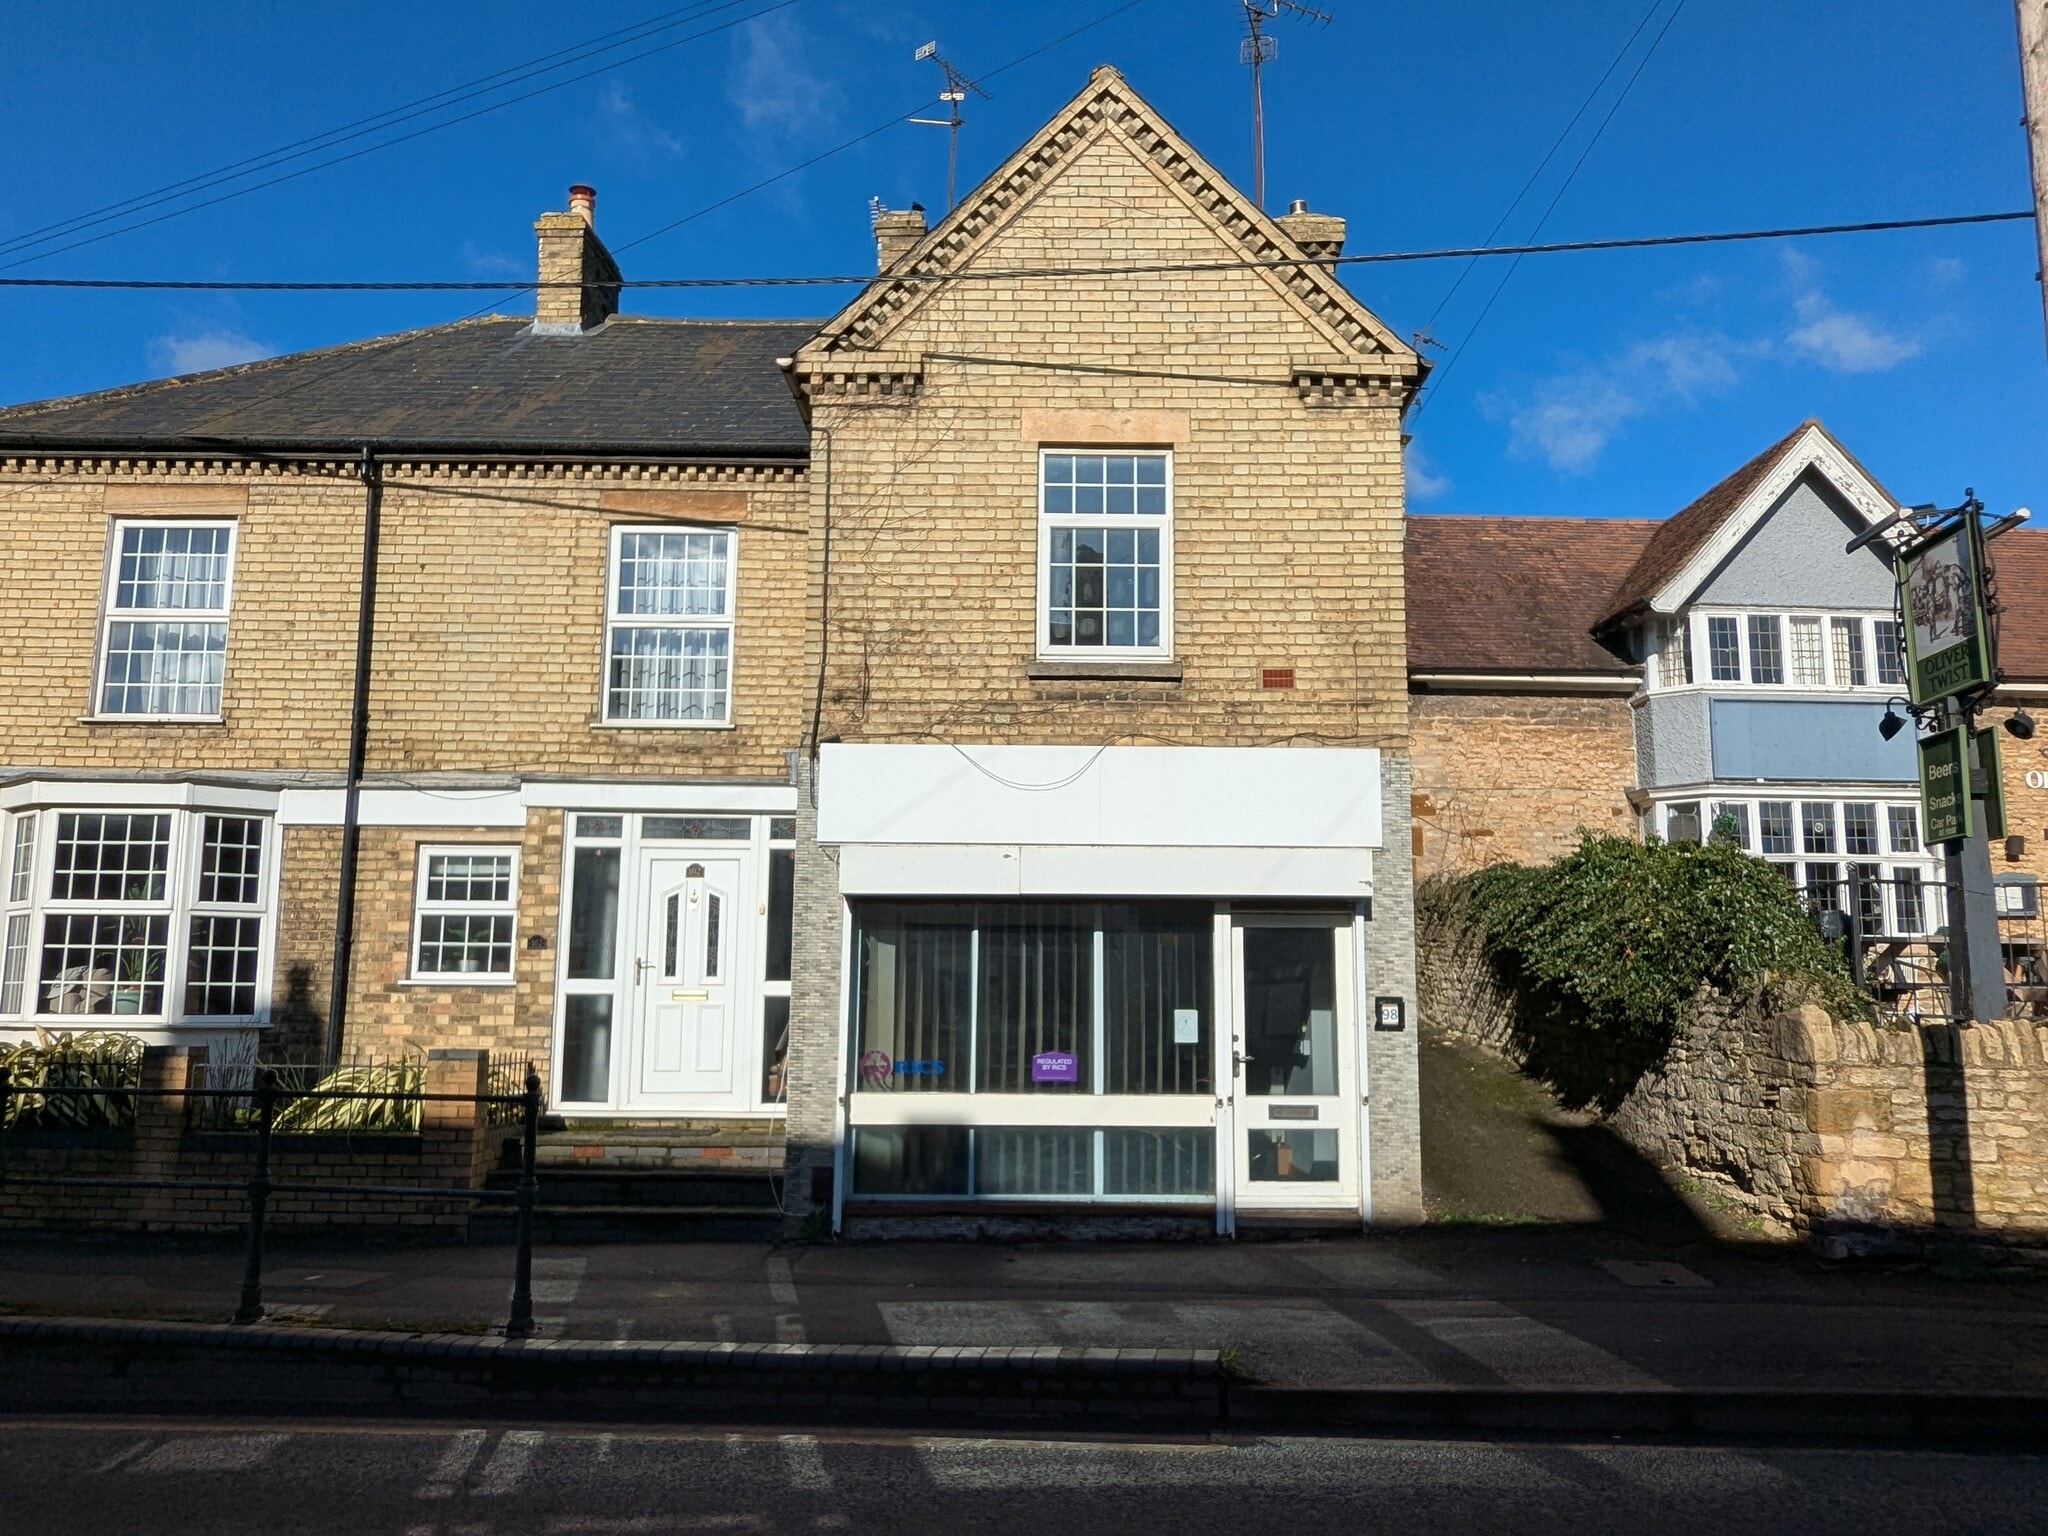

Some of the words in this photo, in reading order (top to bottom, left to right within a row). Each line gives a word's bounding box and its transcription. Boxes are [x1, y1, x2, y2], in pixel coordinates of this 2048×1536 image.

[1925, 643, 1969, 675] OLIVER
[1928, 662, 1968, 693] TWIST
[1929, 761, 1959, 780] Beers
[1929, 791, 1963, 811] Snacks
[1930, 818, 1945, 830] Car
[1383, 1008, 1398, 1020] 98
[895, 1060, 945, 1074] RICS
